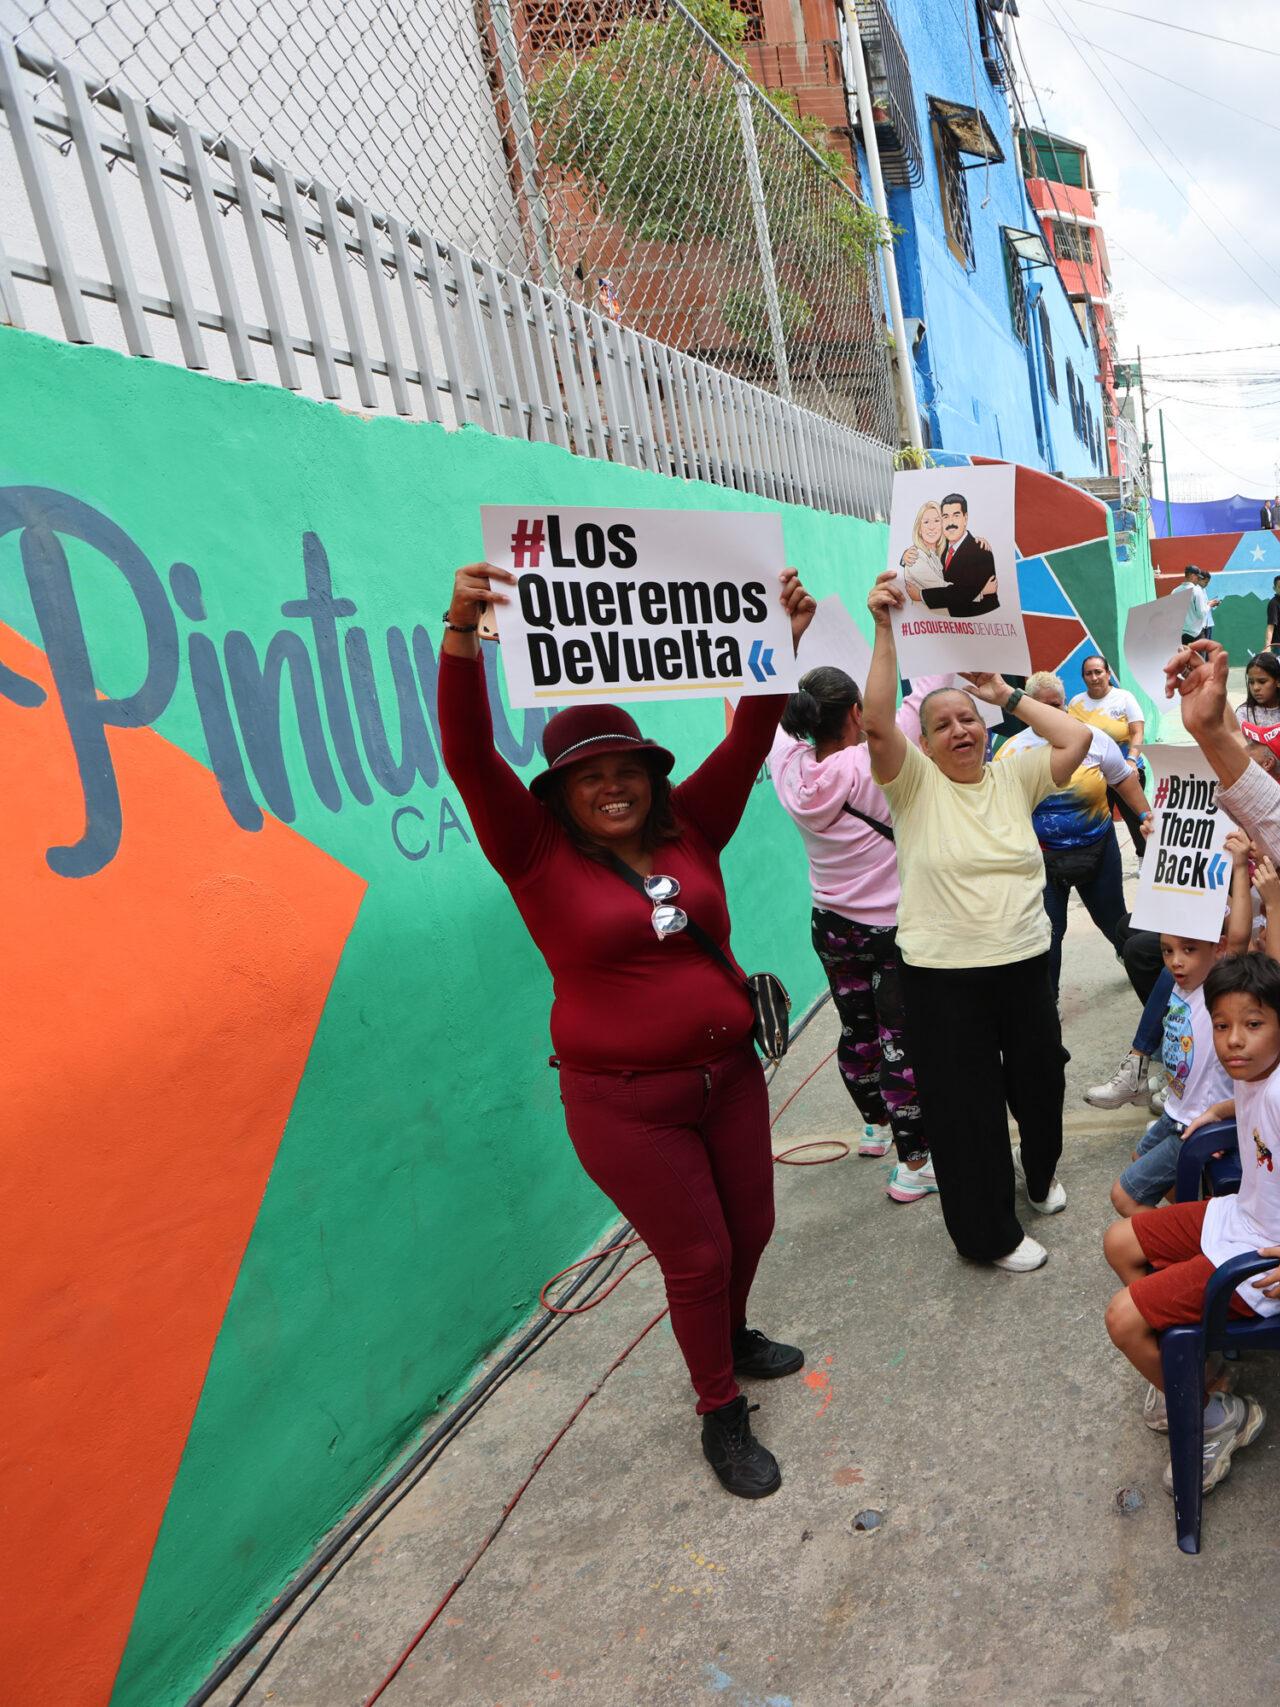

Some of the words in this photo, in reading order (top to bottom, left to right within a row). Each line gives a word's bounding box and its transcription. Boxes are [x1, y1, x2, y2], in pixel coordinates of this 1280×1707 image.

[511, 514, 637, 568] #Los
[517, 573, 768, 630] Queremos
[901, 621, 1017, 637] #LOSQUEREMOSDEVUELTA
[526, 629, 743, 686] DeVuelta
[1154, 774, 1219, 815] #Bring
[1160, 812, 1215, 850] Them
[1154, 848, 1208, 889] Back
